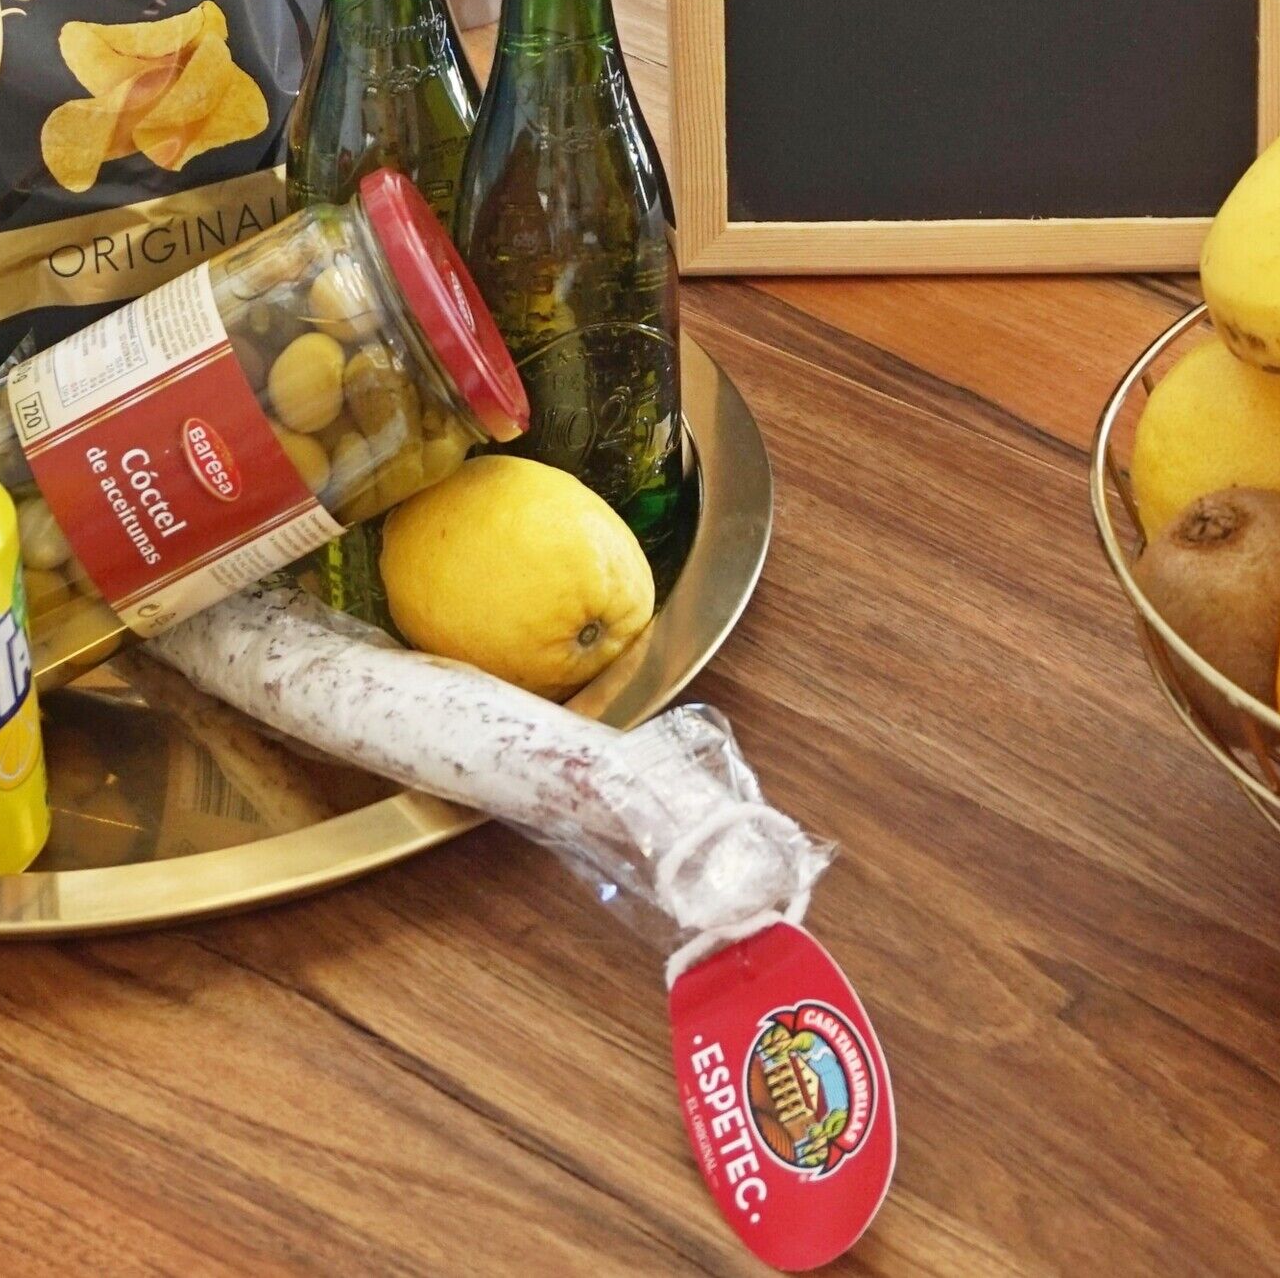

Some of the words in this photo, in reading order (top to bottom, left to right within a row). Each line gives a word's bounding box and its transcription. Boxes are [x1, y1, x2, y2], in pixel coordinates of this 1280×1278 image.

[22, 400, 42, 429] 720
[188, 426, 234, 495] Baresa
[86, 447, 108, 474] de
[100, 476, 161, 565] aceitunas
[121, 448, 188, 538] Cóctel
[691, 1042, 768, 1211] ESPETEC
[803, 1009, 839, 1039] CASA
[834, 1035, 869, 1143] TARRADELLAS
